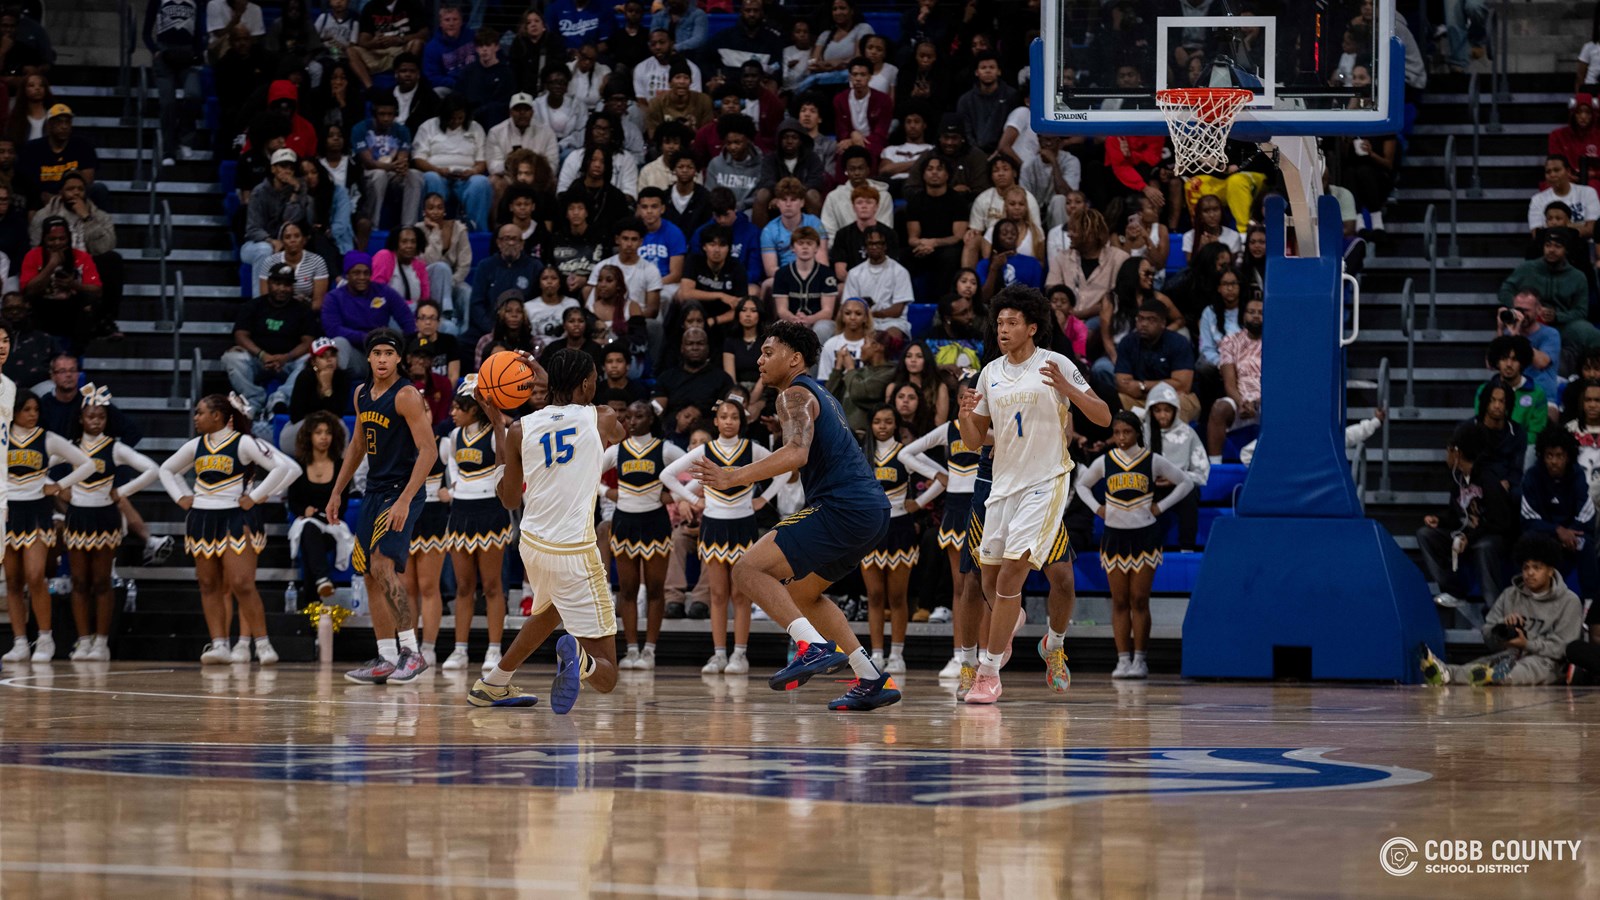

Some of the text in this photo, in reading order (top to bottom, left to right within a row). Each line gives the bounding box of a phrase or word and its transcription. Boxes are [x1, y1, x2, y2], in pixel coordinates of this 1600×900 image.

[1054, 113, 1087, 121] SPALDING
[1014, 411, 1023, 437] 1
[366, 427, 377, 455] 2
[538, 426, 578, 468] 15
[1107, 472, 1149, 494] WILDCATS
